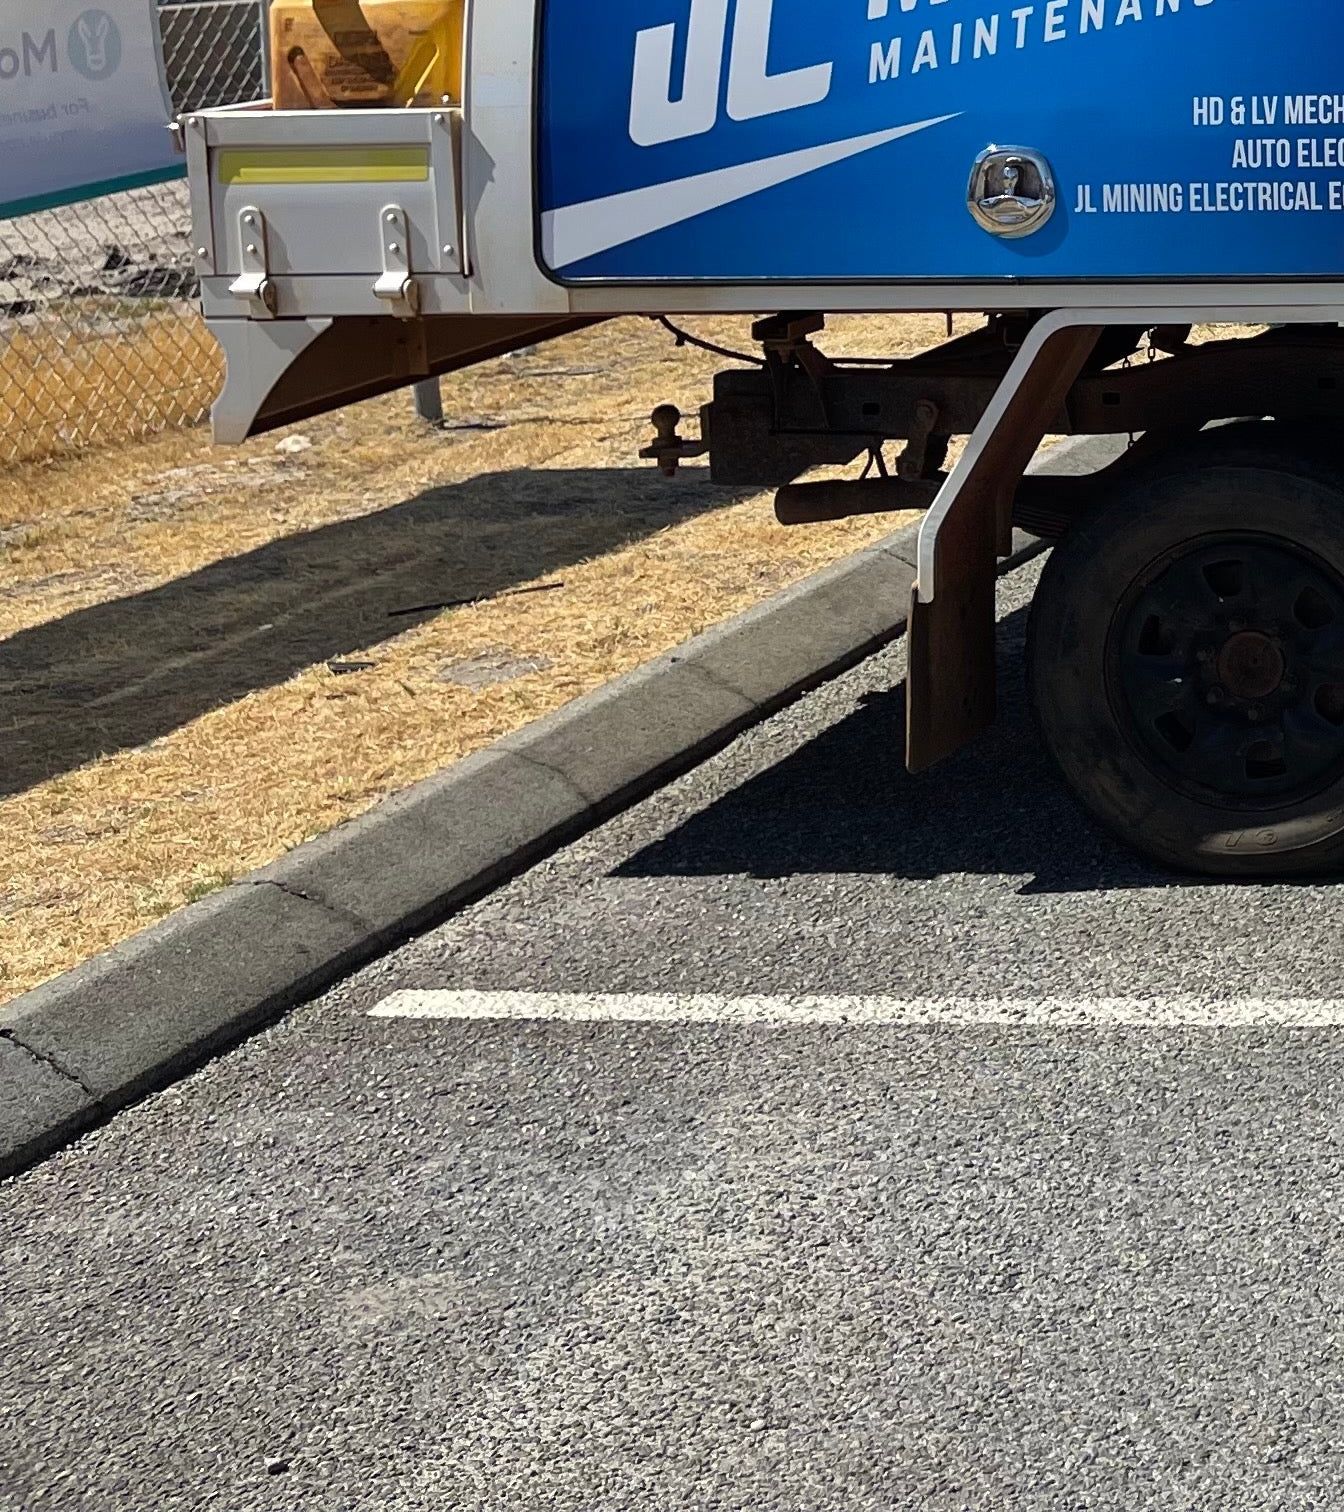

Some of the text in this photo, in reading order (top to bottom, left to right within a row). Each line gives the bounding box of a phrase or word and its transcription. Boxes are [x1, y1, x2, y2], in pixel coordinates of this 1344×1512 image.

[1192, 96, 1224, 126] HD
[1231, 96, 1245, 125] &
[1251, 95, 1278, 125] LV
[1232, 139, 1290, 168] AUTO
[1074, 185, 1097, 213] JL
[1102, 183, 1183, 212] MINING
[1188, 181, 1323, 212] ELECTRICAL
